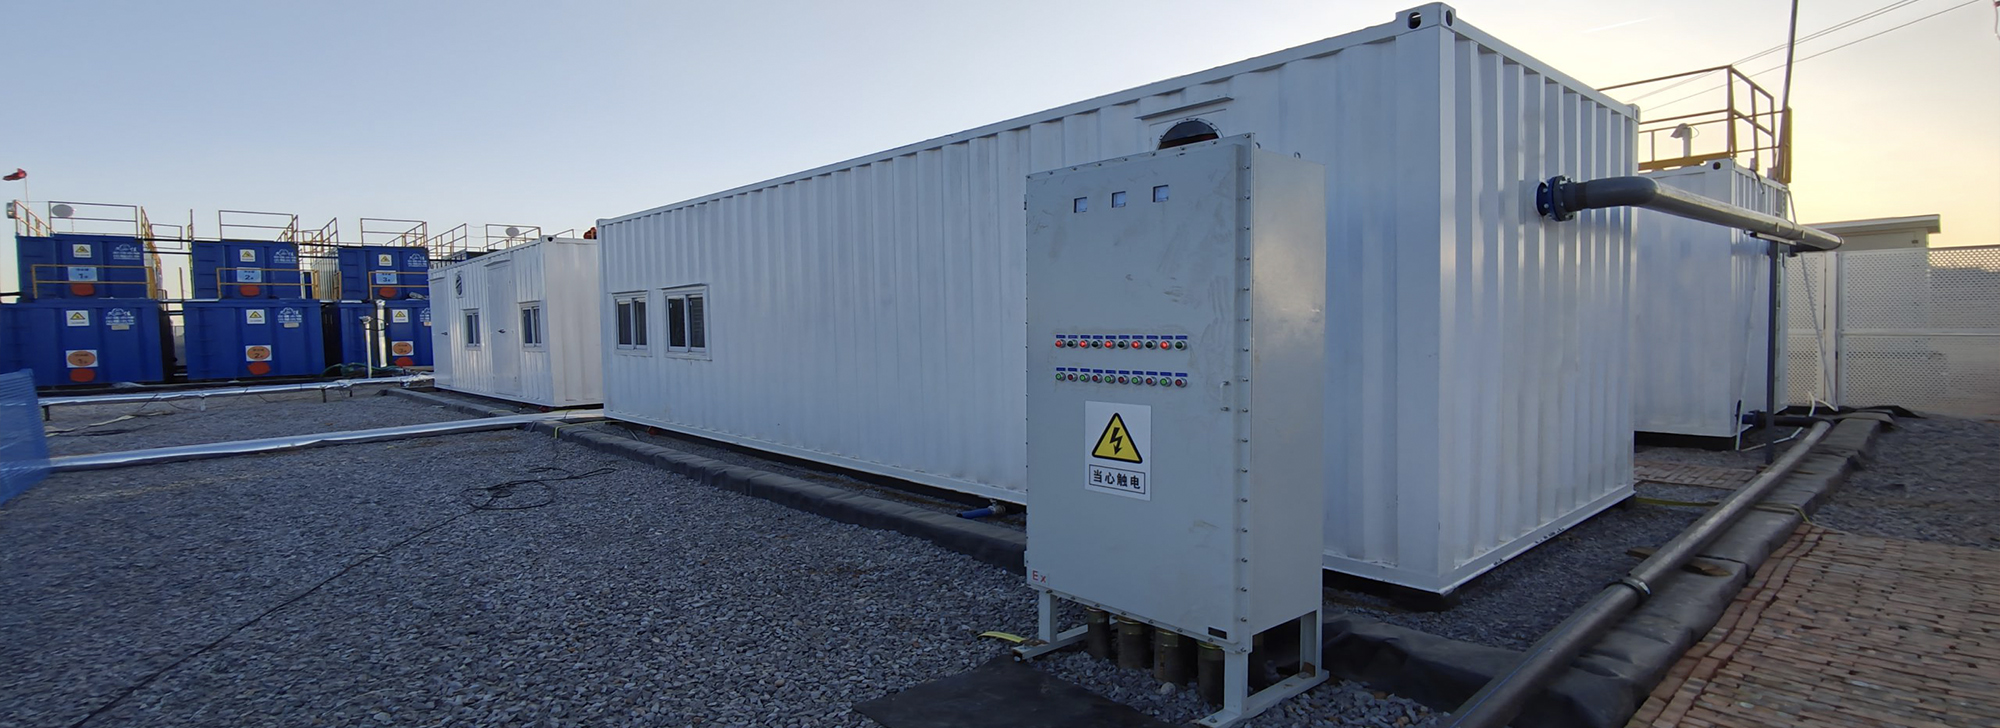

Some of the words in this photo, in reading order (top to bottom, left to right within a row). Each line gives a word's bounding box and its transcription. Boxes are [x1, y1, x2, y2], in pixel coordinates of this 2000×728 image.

[1093, 469, 1141, 490] 当心触电
[1032, 570, 1046, 583] Ex
